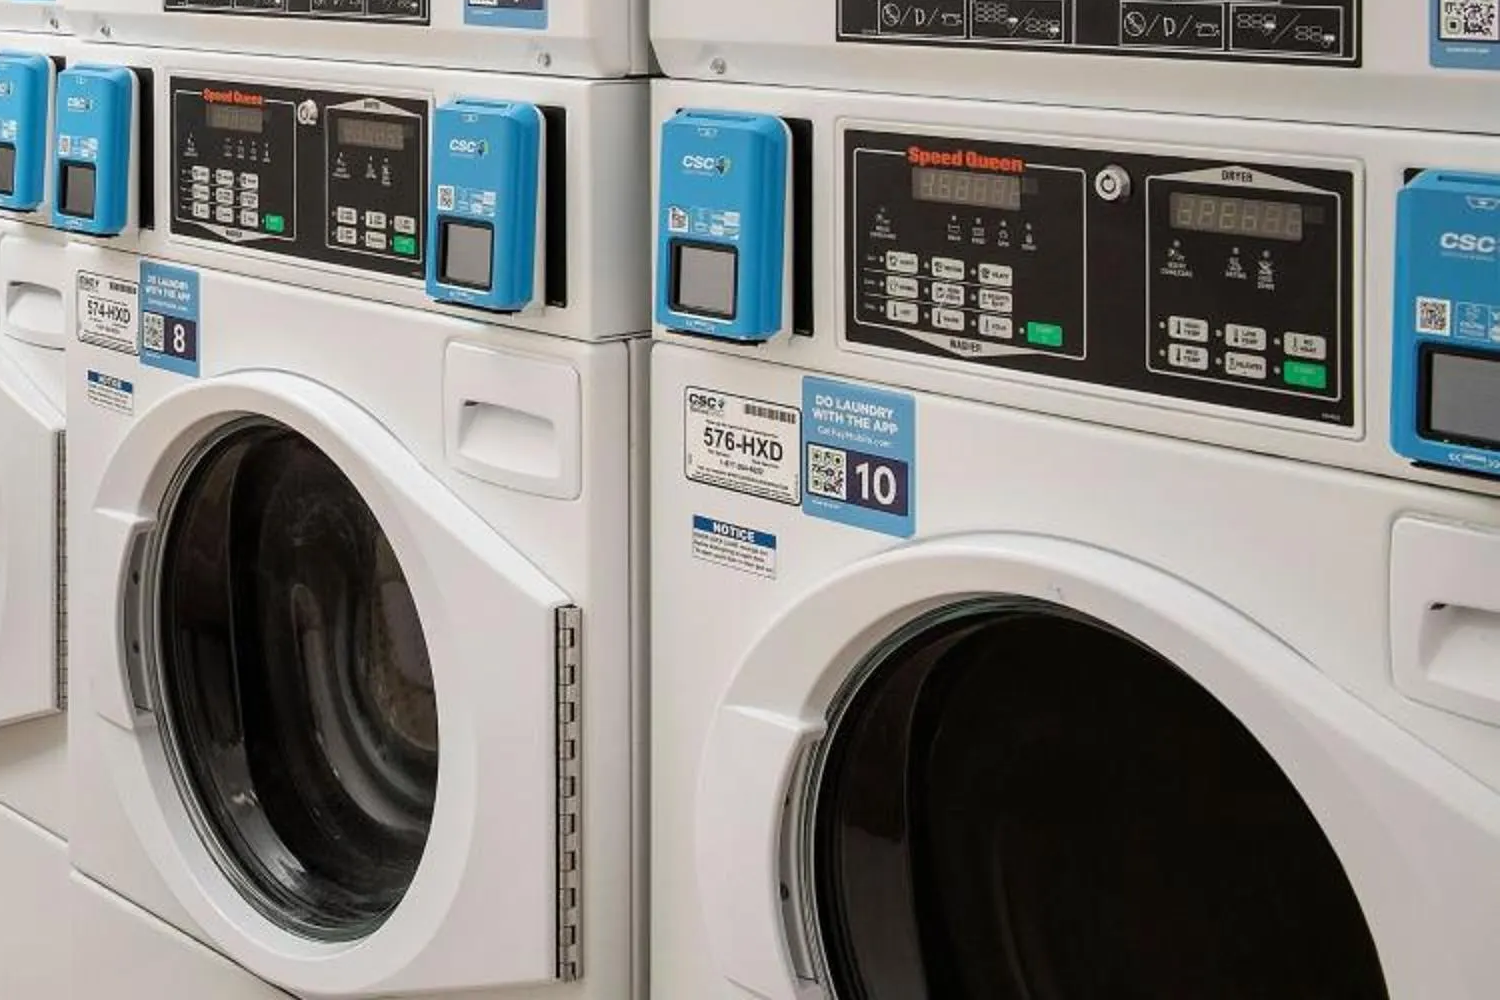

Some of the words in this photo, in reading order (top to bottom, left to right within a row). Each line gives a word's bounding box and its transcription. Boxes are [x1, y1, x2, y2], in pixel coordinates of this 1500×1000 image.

[450, 139, 477, 153] CSC
[908, 146, 964, 167] Speed
[966, 150, 1024, 172] Queen
[682, 155, 714, 169] CSC
[1221, 169, 1253, 183] DRYER
[1441, 232, 1496, 252] CSC
[87, 299, 131, 325] 574-HXD
[173, 323, 185, 353] 8
[689, 393, 716, 409] CSC
[815, 394, 833, 408] DO
[835, 398, 894, 420] LAUNDRY
[812, 407, 845, 424] WITH
[847, 414, 871, 429] THE
[873, 418, 899, 435] APP
[703, 427, 783, 461] 576-HXD
[855, 462, 897, 505] 10
[712, 521, 755, 543] NOTICE
